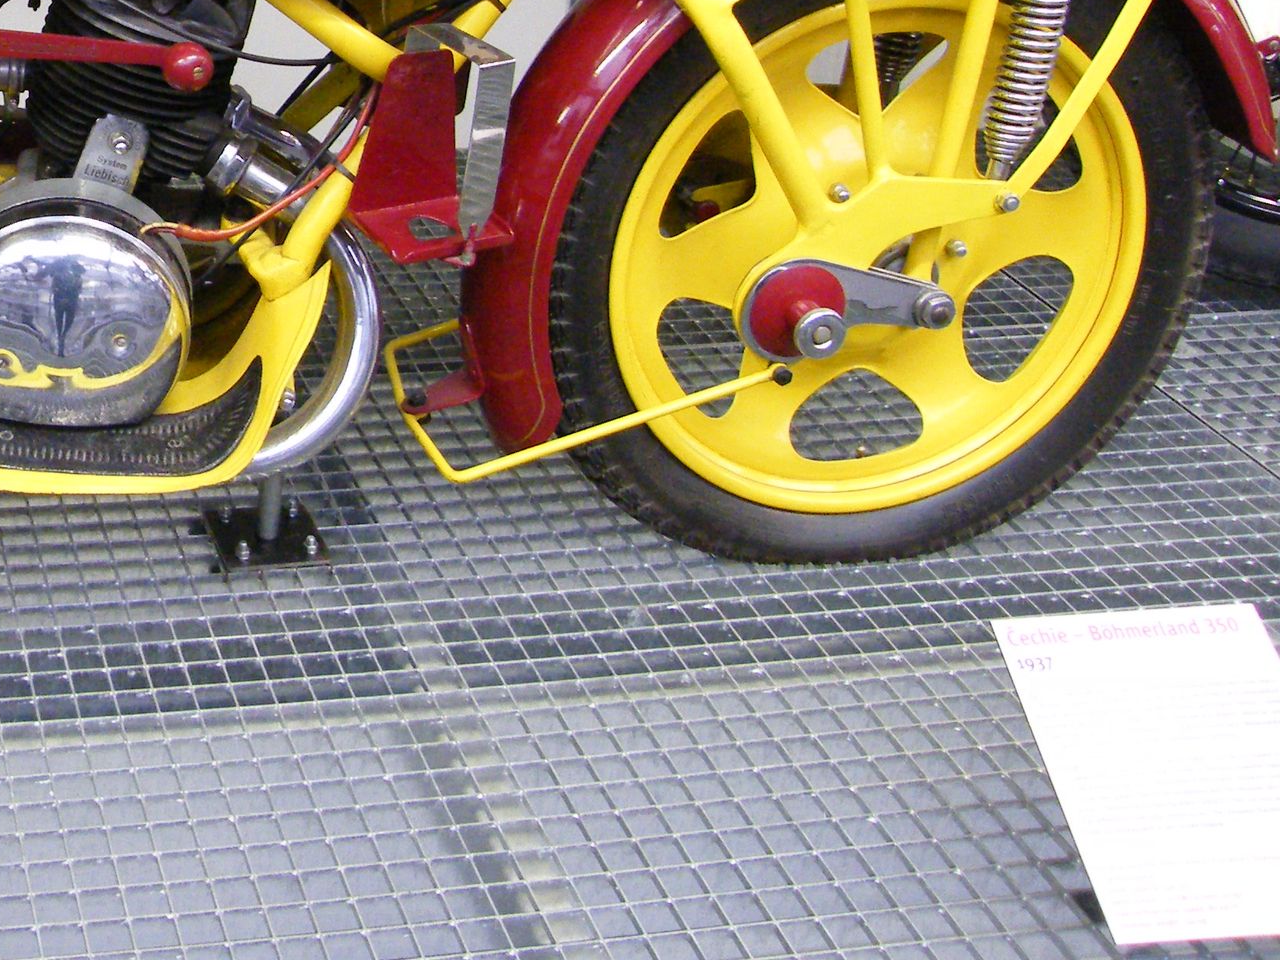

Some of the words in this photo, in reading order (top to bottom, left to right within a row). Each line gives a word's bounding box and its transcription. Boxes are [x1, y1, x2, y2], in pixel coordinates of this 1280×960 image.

[83, 162, 130, 187] Liebisch
[1087, 618, 1200, 642] Böhmerland
[1205, 616, 1240, 633] 350
[1016, 656, 1053, 672] 1937
